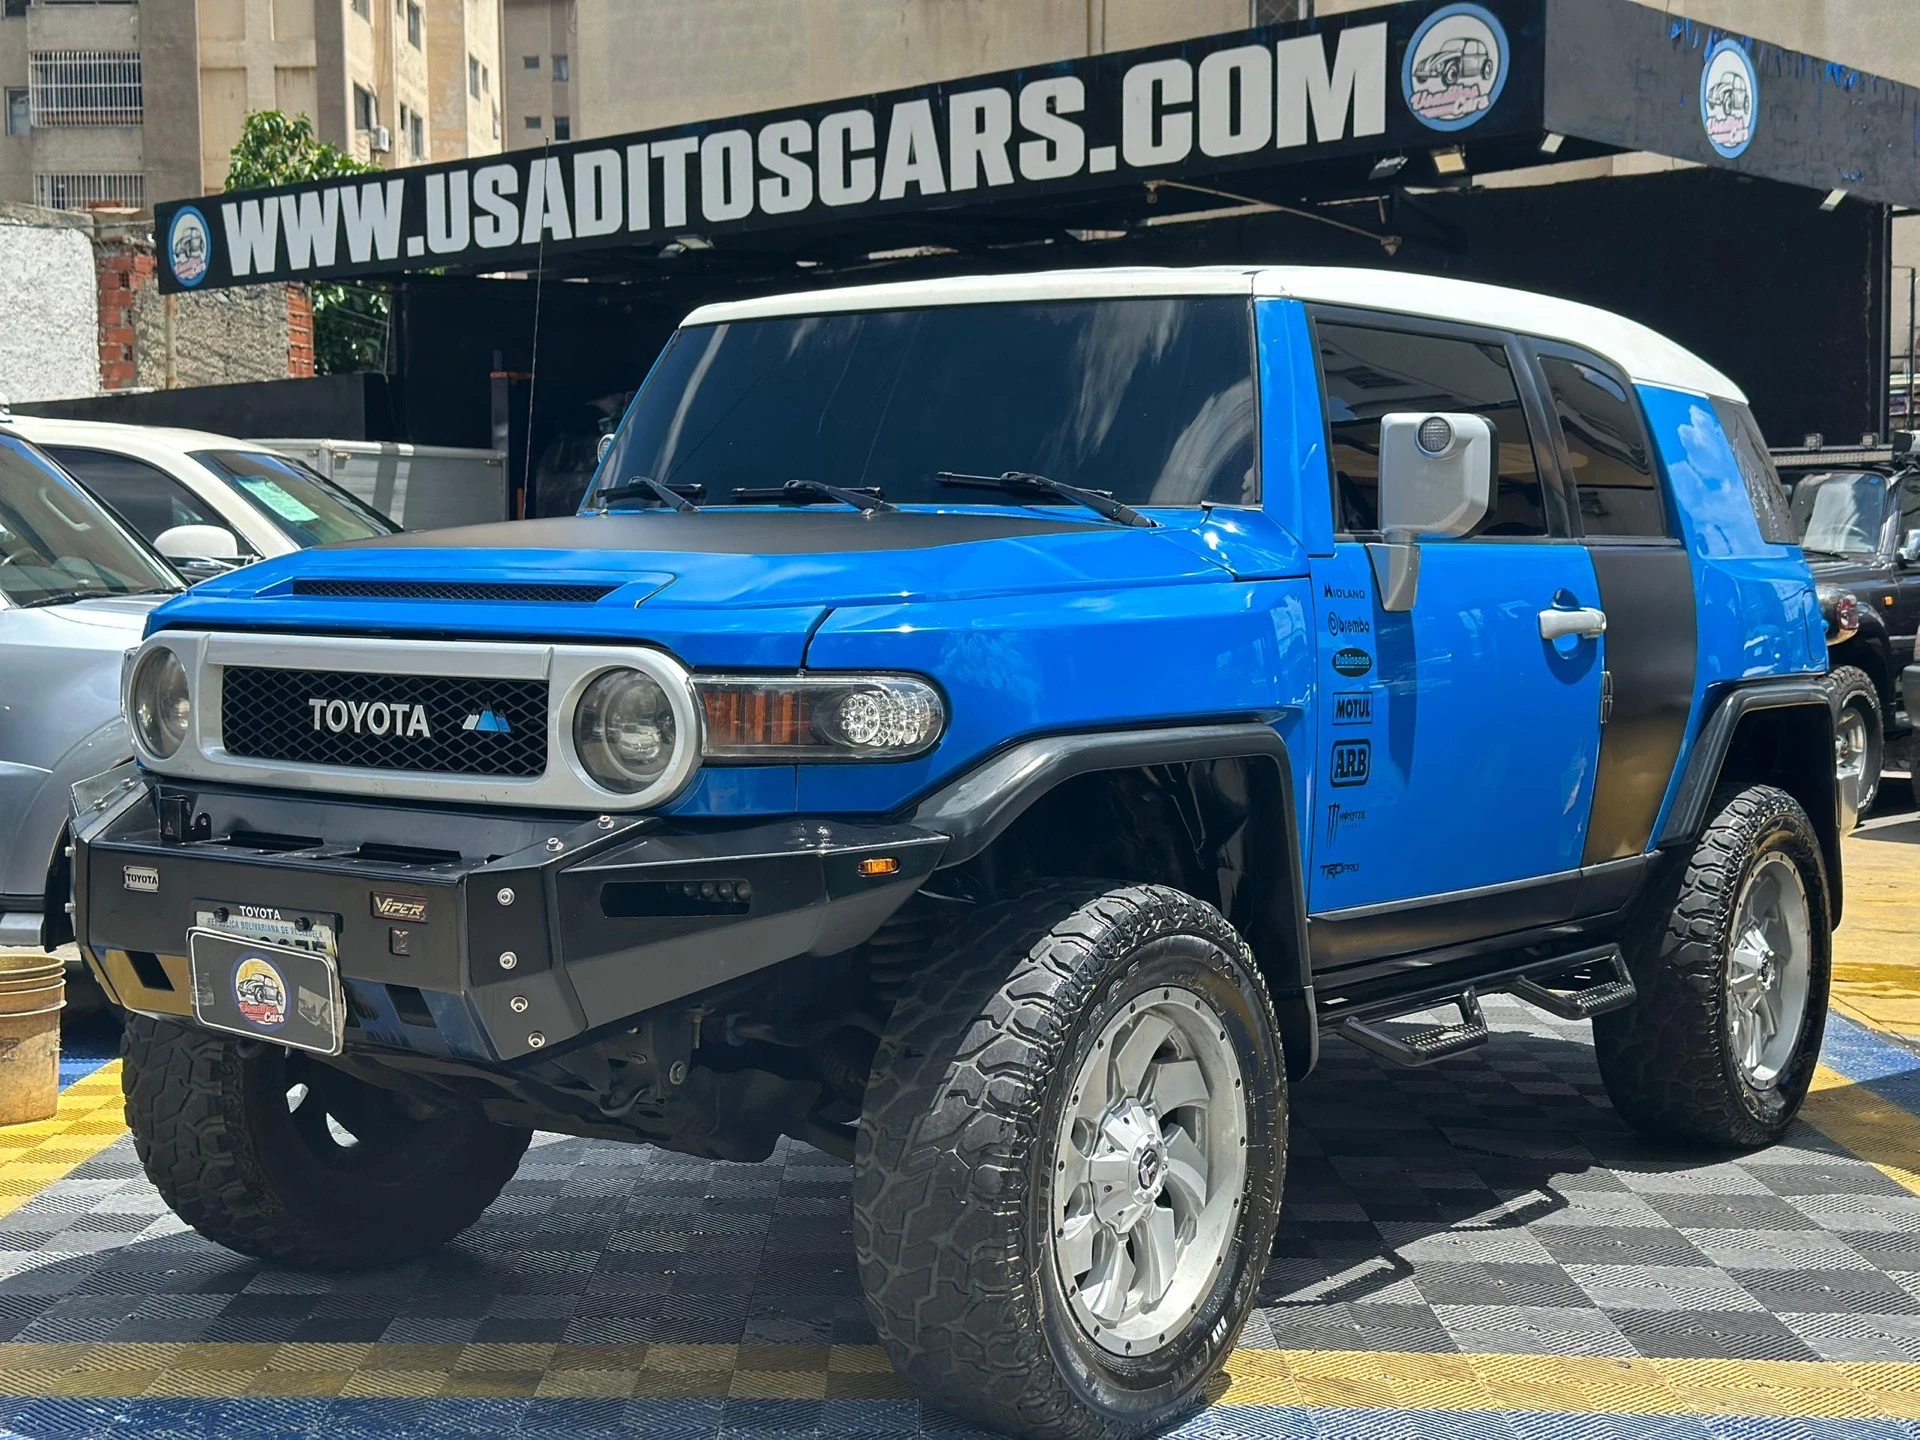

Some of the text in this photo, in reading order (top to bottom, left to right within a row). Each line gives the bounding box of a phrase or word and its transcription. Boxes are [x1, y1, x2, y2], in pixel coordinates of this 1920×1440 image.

[221, 22, 1388, 277] WWW.USADITOSCARS.COM
[1338, 616, 1370, 633] brembo
[1335, 699, 1371, 719] MOTUL
[309, 698, 431, 738] TOYOTA
[1334, 748, 1368, 779] ARB
[126, 873, 158, 885] TOYOTA
[239, 905, 281, 920] TOYOTA
[240, 920, 279, 933] BOLIVARIANA
[280, 925, 290, 935] DE
[264, 1011, 285, 1023] Cars
